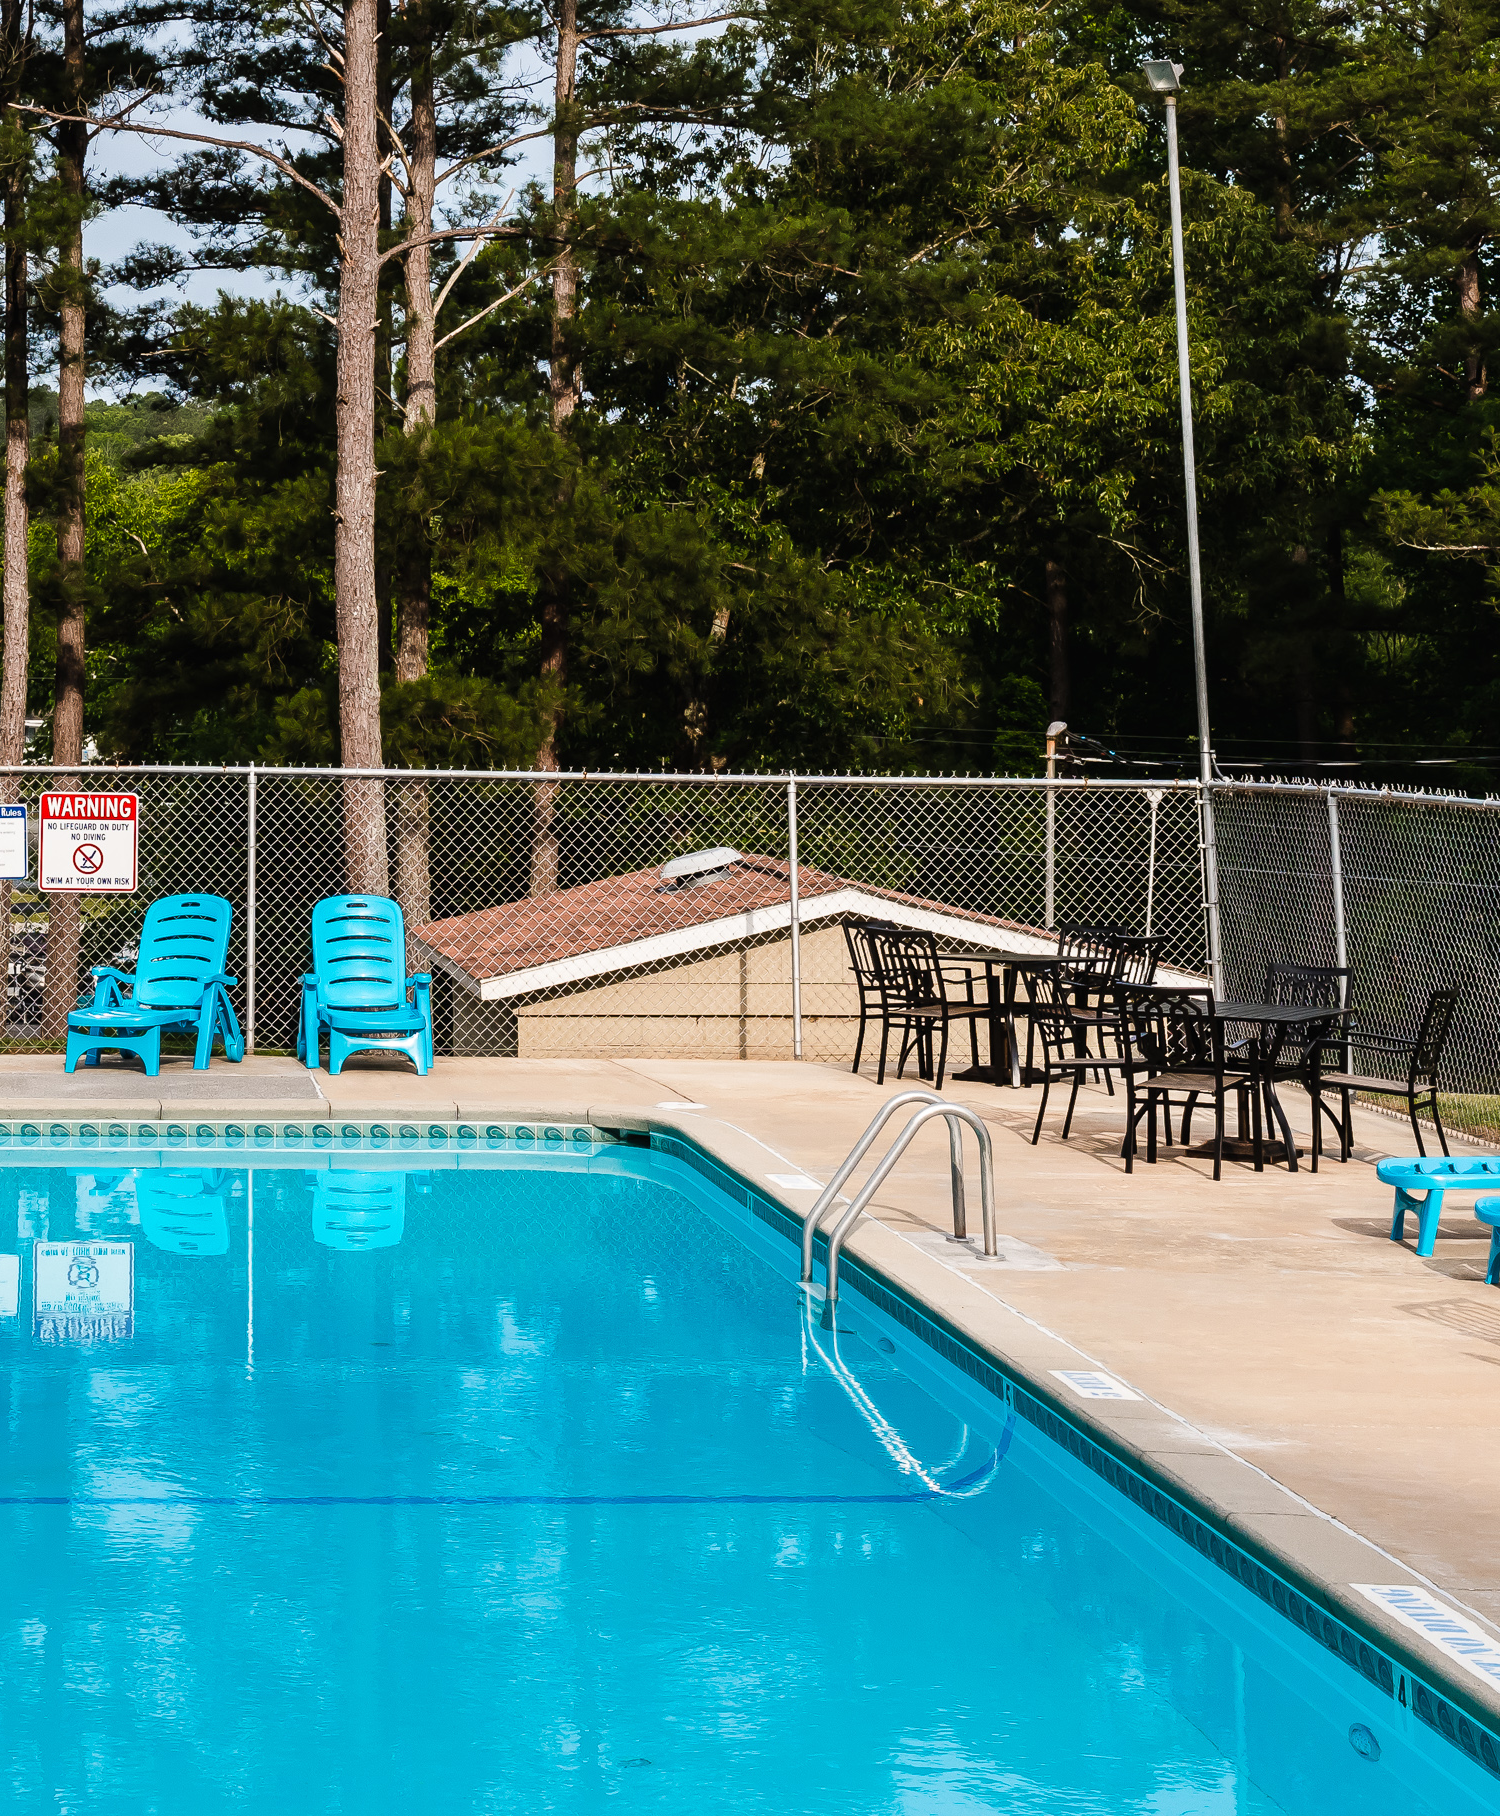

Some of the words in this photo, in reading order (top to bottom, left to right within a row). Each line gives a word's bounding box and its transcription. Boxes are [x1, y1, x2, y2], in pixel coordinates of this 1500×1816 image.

[47, 796, 131, 818] WARNING
[1, 807, 22, 817] Rules
[47, 822, 57, 830] NO
[60, 822, 97, 831] LIFEGUARD
[100, 823, 109, 831] ON
[112, 823, 129, 831] DUTY
[71, 833, 80, 841] NO
[83, 833, 106, 841] DIVING
[46, 876, 63, 885] SWIM
[76, 877, 94, 885] YOUR
[97, 877, 112, 885] OWN
[114, 877, 130, 885] RISK
[1370, 1587, 1469, 1633] DIVING
